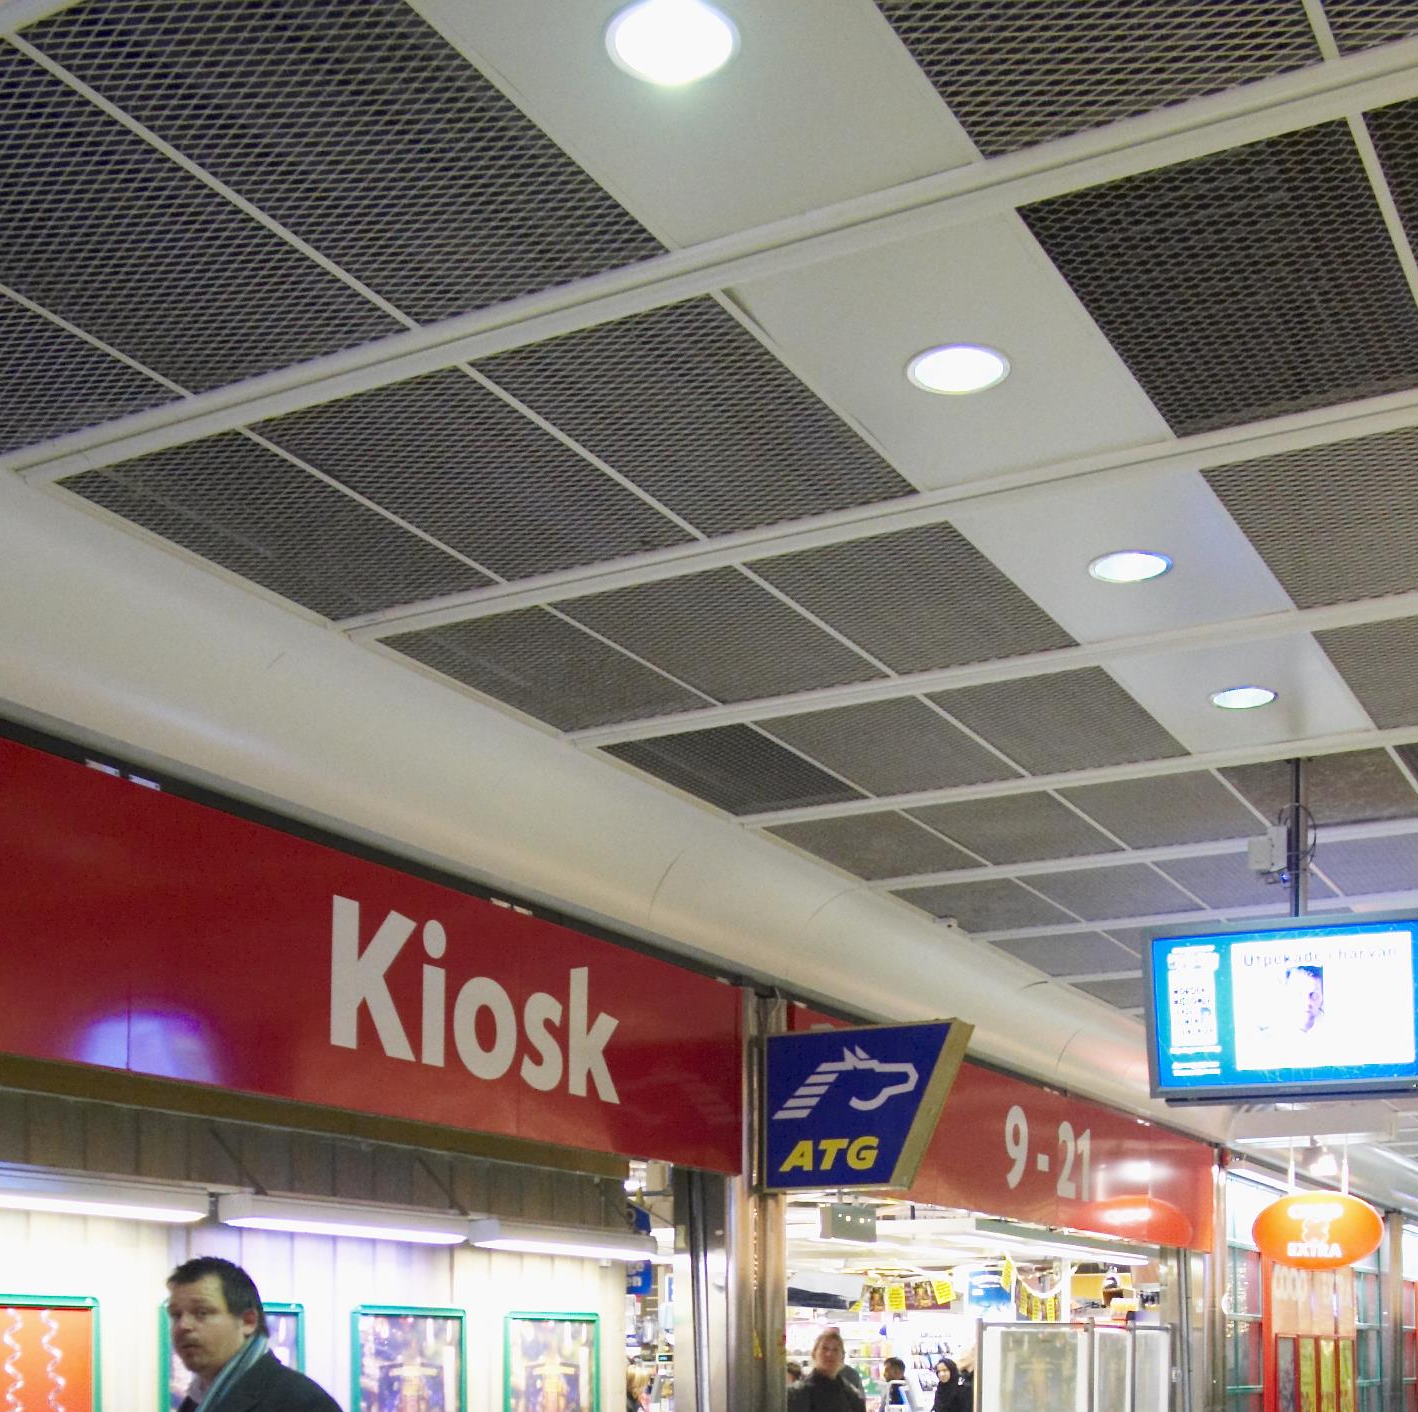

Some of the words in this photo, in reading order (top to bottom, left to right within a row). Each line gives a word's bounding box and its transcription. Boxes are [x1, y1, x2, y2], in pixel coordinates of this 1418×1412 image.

[331, 894, 620, 1105] Kiosk
[779, 1136, 879, 1173] ATG
[1005, 1105, 1029, 1190] 9
[1057, 1121, 1091, 1201] 21
[1287, 1242, 1342, 1259] EXTRA
